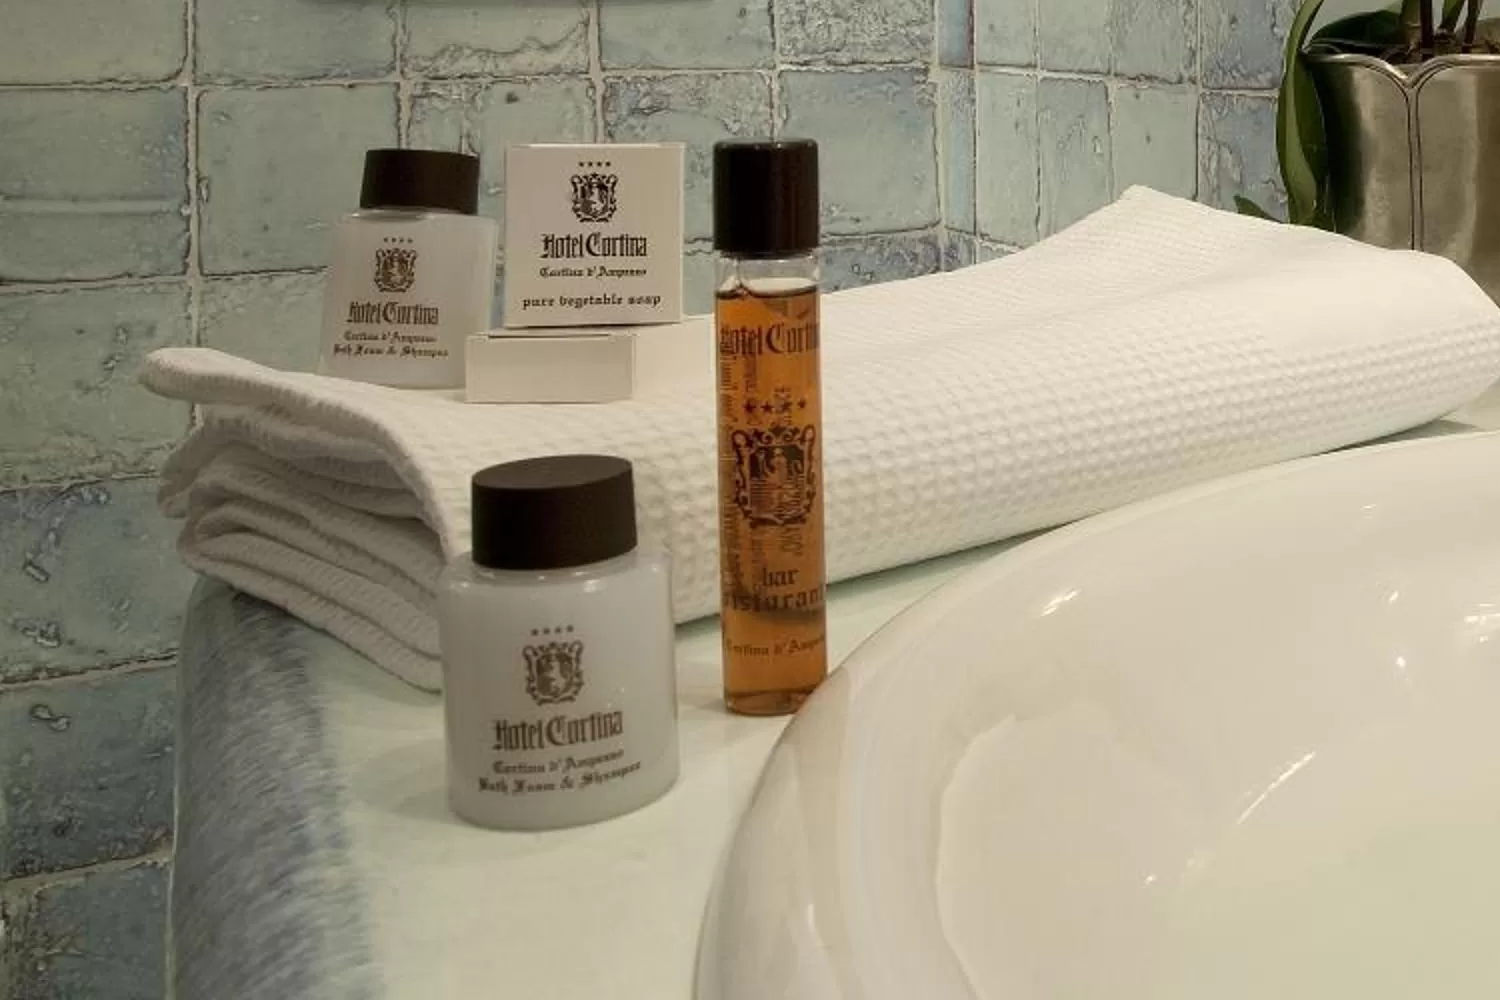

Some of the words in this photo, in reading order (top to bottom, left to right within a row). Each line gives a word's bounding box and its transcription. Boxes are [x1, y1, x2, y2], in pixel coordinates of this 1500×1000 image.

[538, 232, 584, 259] Hotel
[585, 231, 648, 258] Cortina
[345, 301, 381, 325] Hotel
[381, 301, 440, 325] Cortina
[522, 296, 555, 311] pure
[559, 292, 623, 309] vegetable
[626, 295, 661, 308] soap
[765, 322, 819, 354] Corti
[761, 567, 800, 587] bar
[491, 718, 546, 752] Hotel
[546, 710, 624, 747] Cortina
